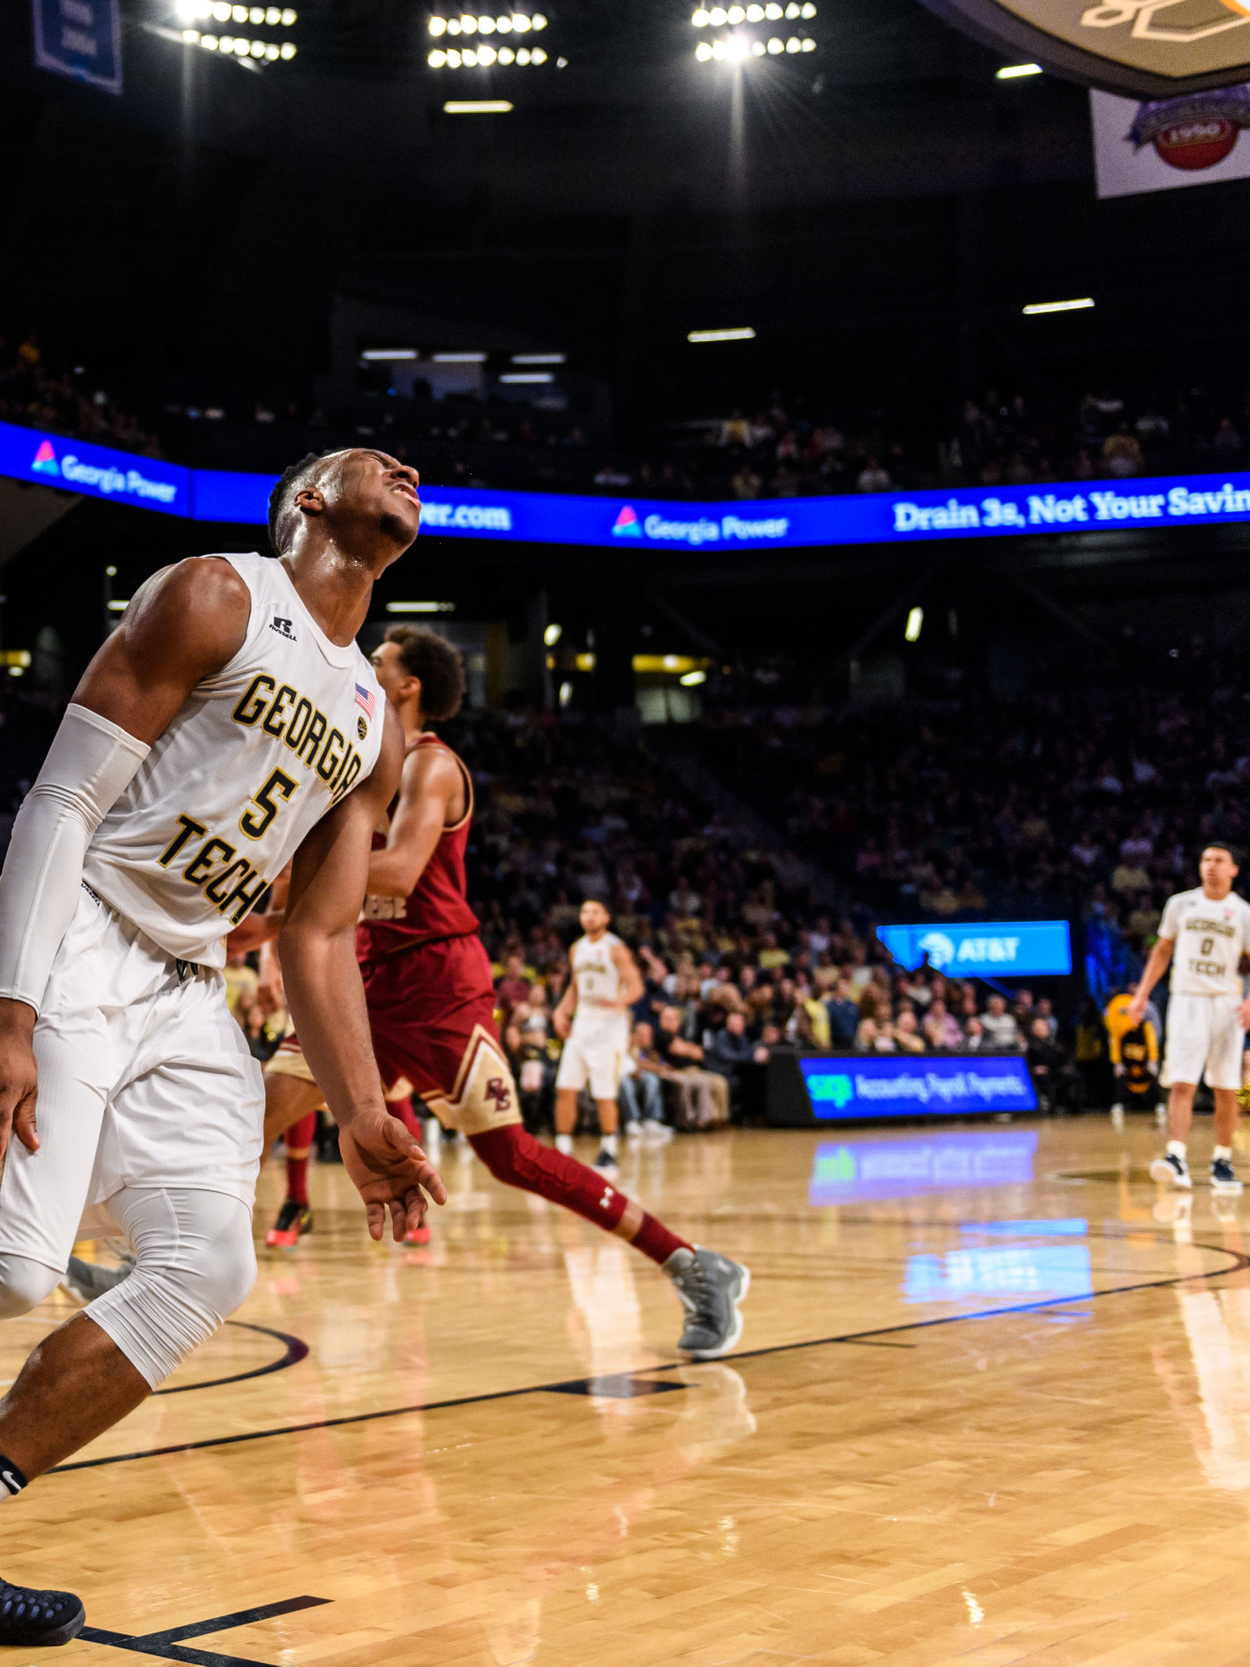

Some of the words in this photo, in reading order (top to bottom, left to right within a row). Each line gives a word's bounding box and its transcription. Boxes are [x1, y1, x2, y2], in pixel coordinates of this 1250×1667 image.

[61, 454, 126, 493] Georgia
[126, 469, 177, 503] Power
[644, 514, 720, 545] Georgia
[721, 515, 789, 541] Power
[893, 498, 980, 532] Drain
[1027, 495, 1088, 524] Not
[1089, 491, 1165, 520] Your
[268, 624, 298, 642] RUSSELL
[231, 672, 362, 806] GEORGIA
[239, 766, 299, 841] 5
[156, 813, 269, 927] TECH
[957, 936, 1020, 963] AT&T
